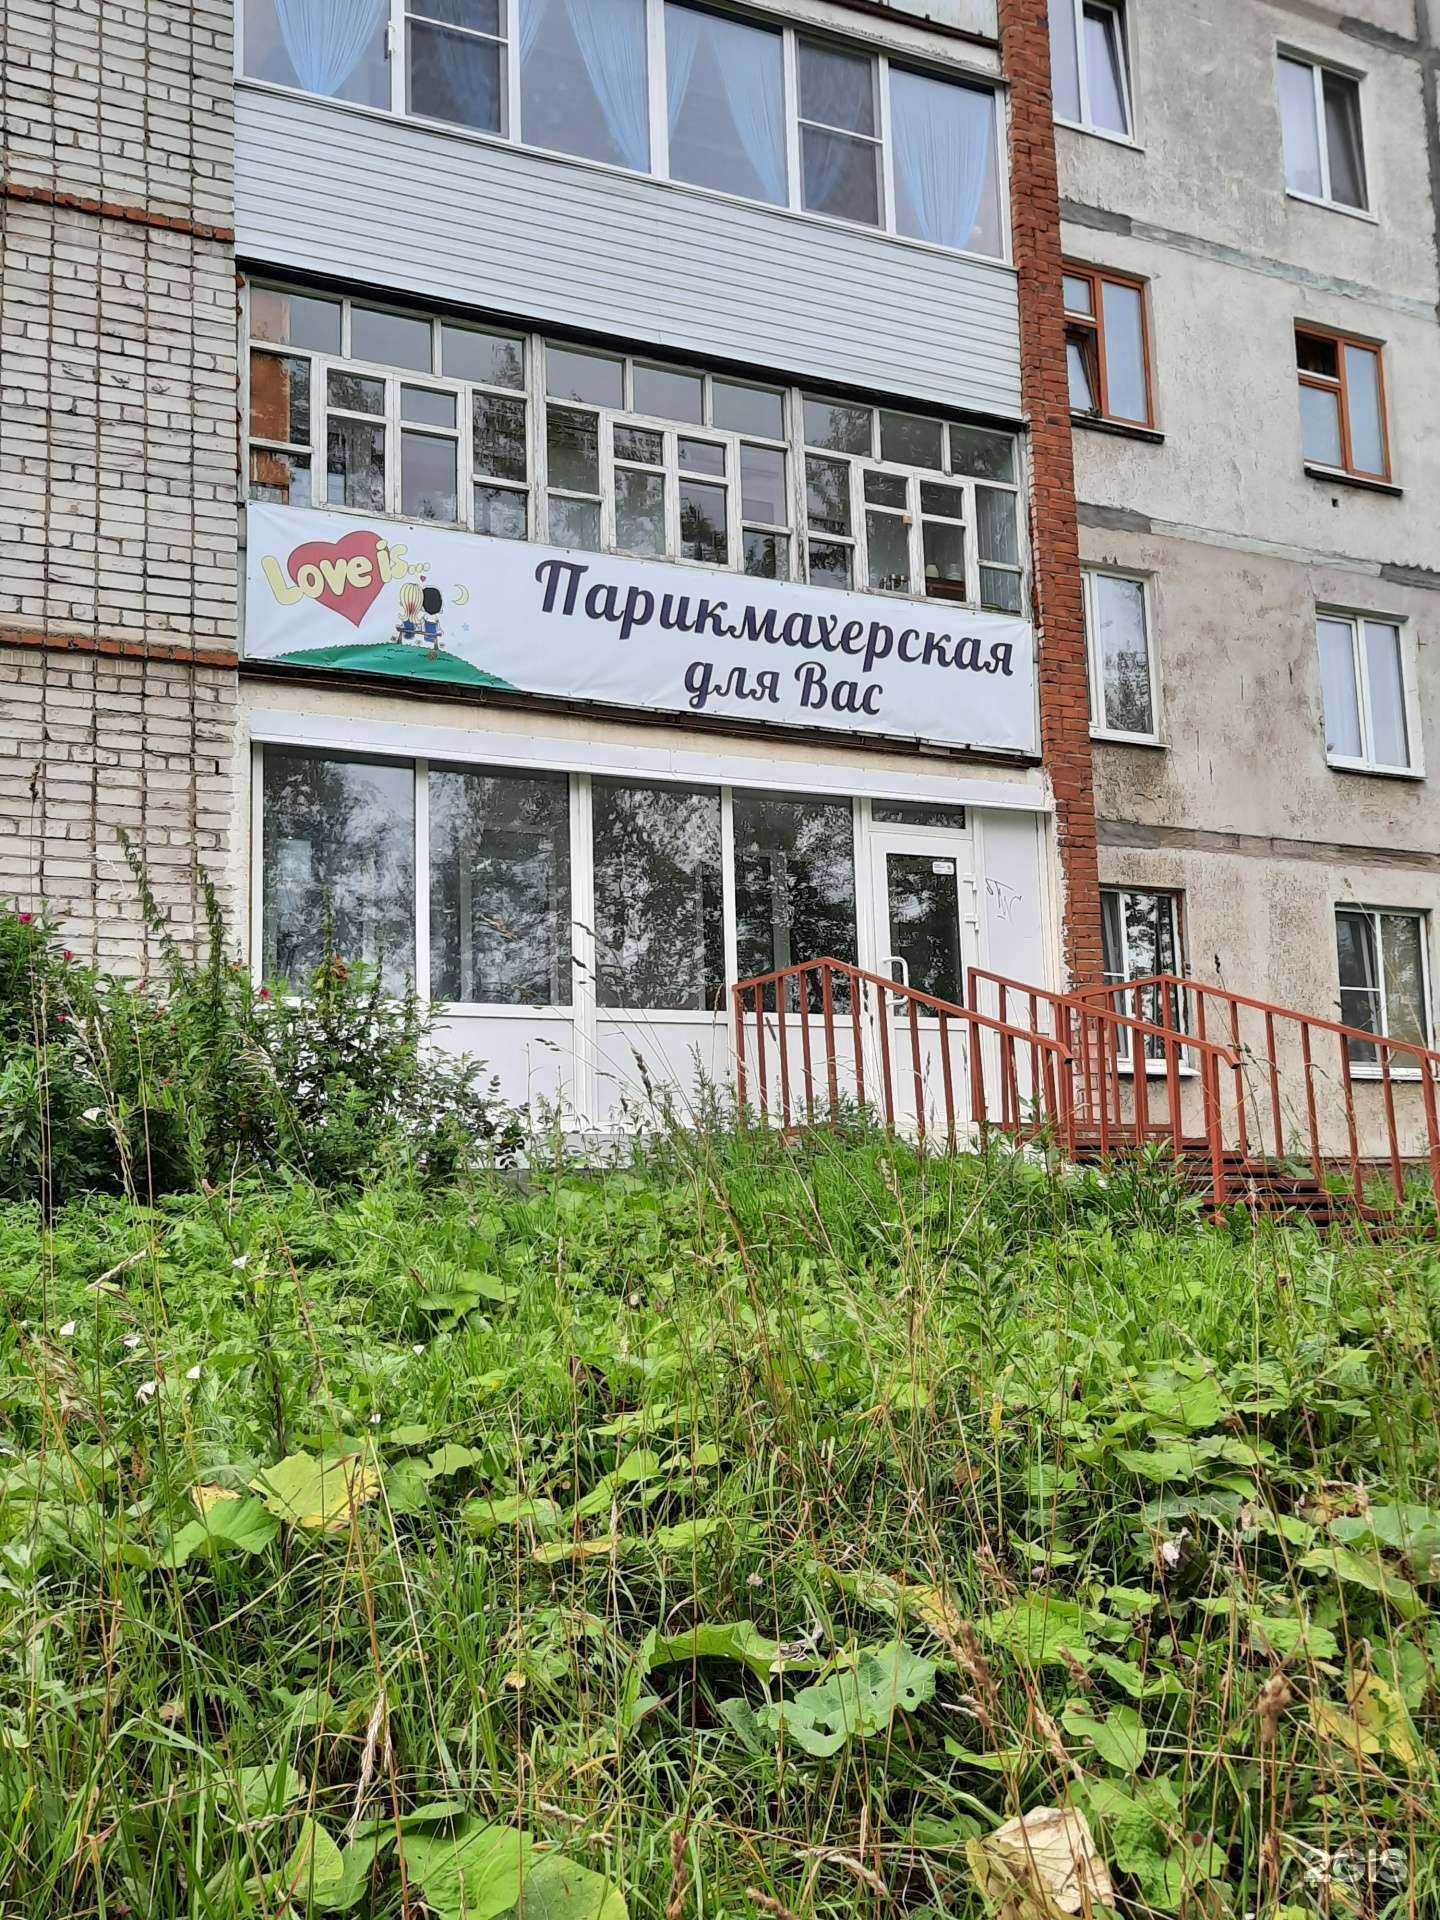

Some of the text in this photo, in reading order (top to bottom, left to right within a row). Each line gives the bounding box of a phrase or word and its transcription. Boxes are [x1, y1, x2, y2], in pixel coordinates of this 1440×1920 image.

[261, 552, 373, 606] Love
[535, 559, 1014, 676] Парикмахерская
[684, 661, 884, 715] для Вас
